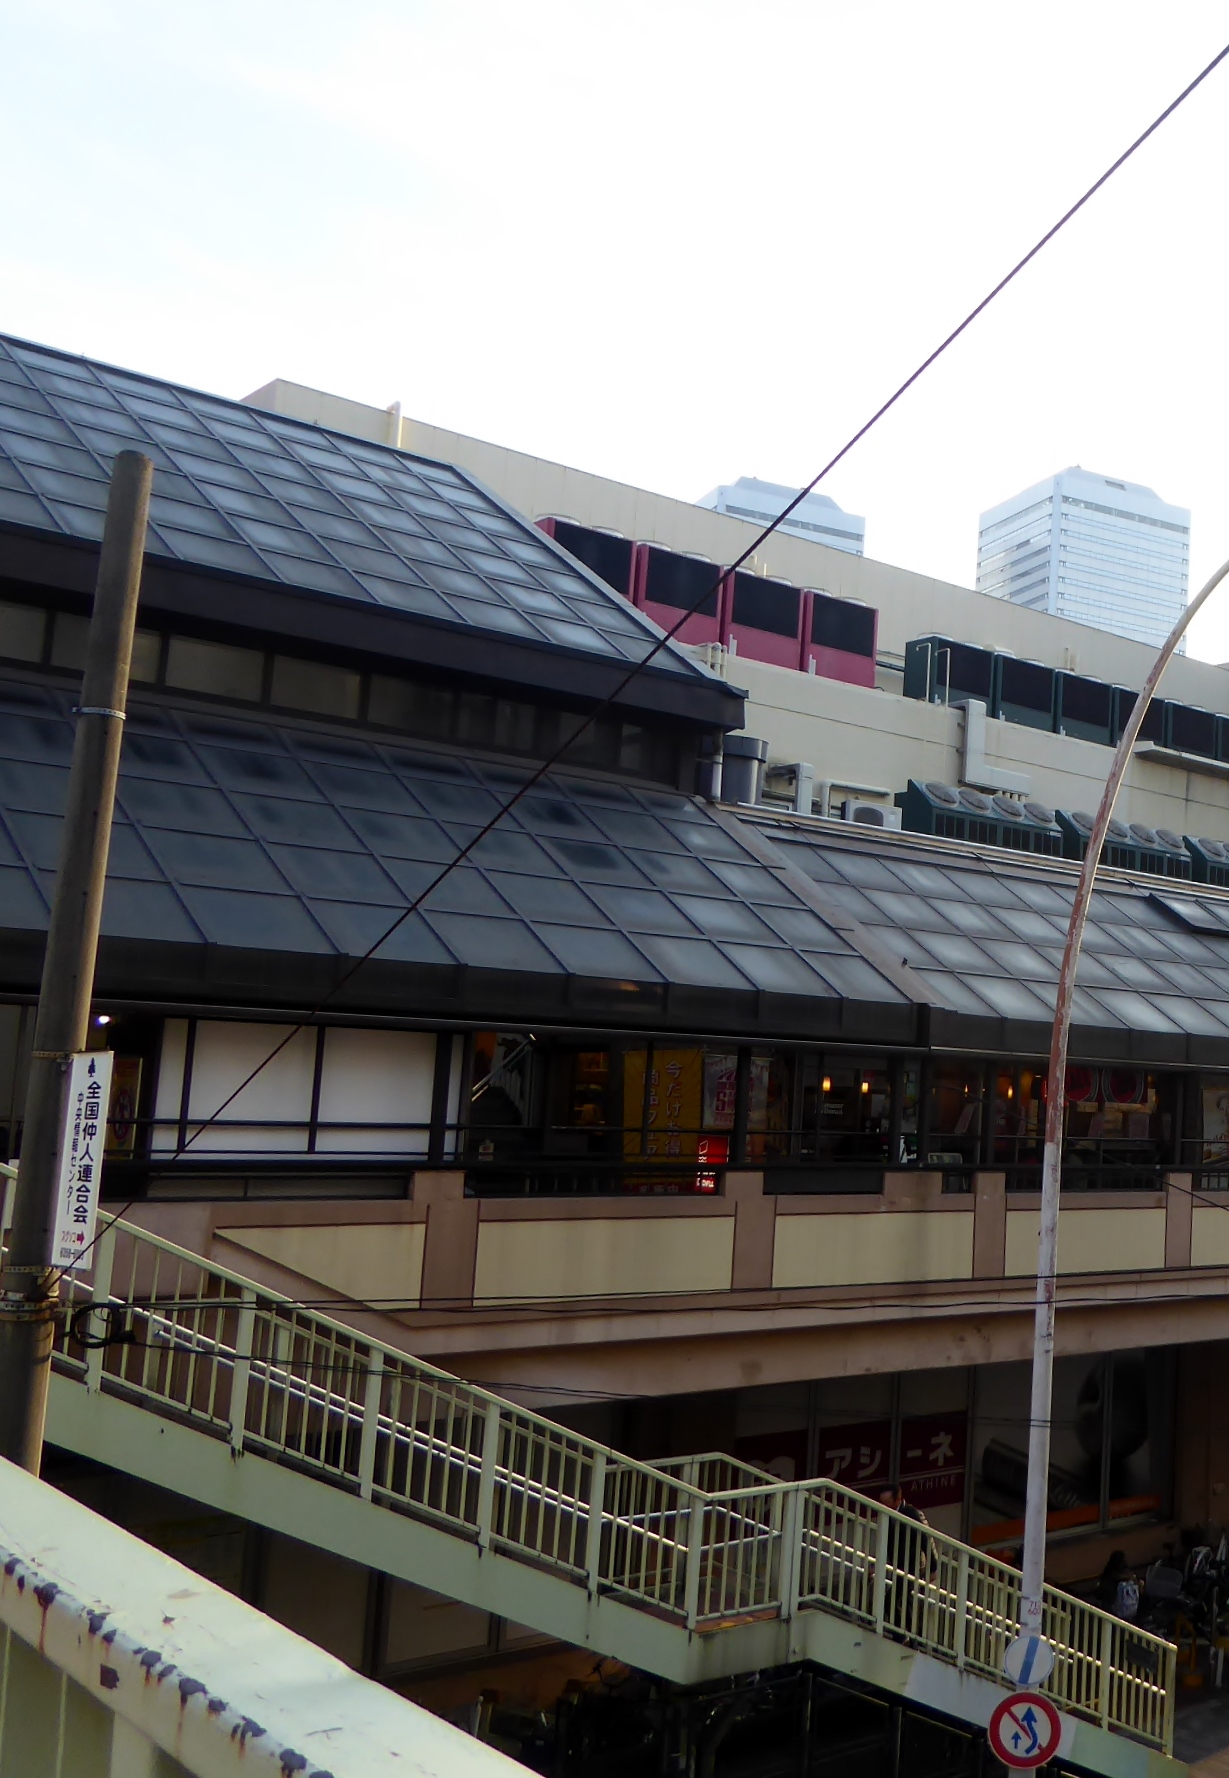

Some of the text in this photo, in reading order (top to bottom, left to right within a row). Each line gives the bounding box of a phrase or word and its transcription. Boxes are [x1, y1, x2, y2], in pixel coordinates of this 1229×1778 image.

[66, 1090, 84, 1216] 中央情報センター
[73, 1081, 102, 1225] 全国仲人連合会
[824, 1431, 954, 1479] アシーネ
[910, 1474, 957, 1492] ATHINE
